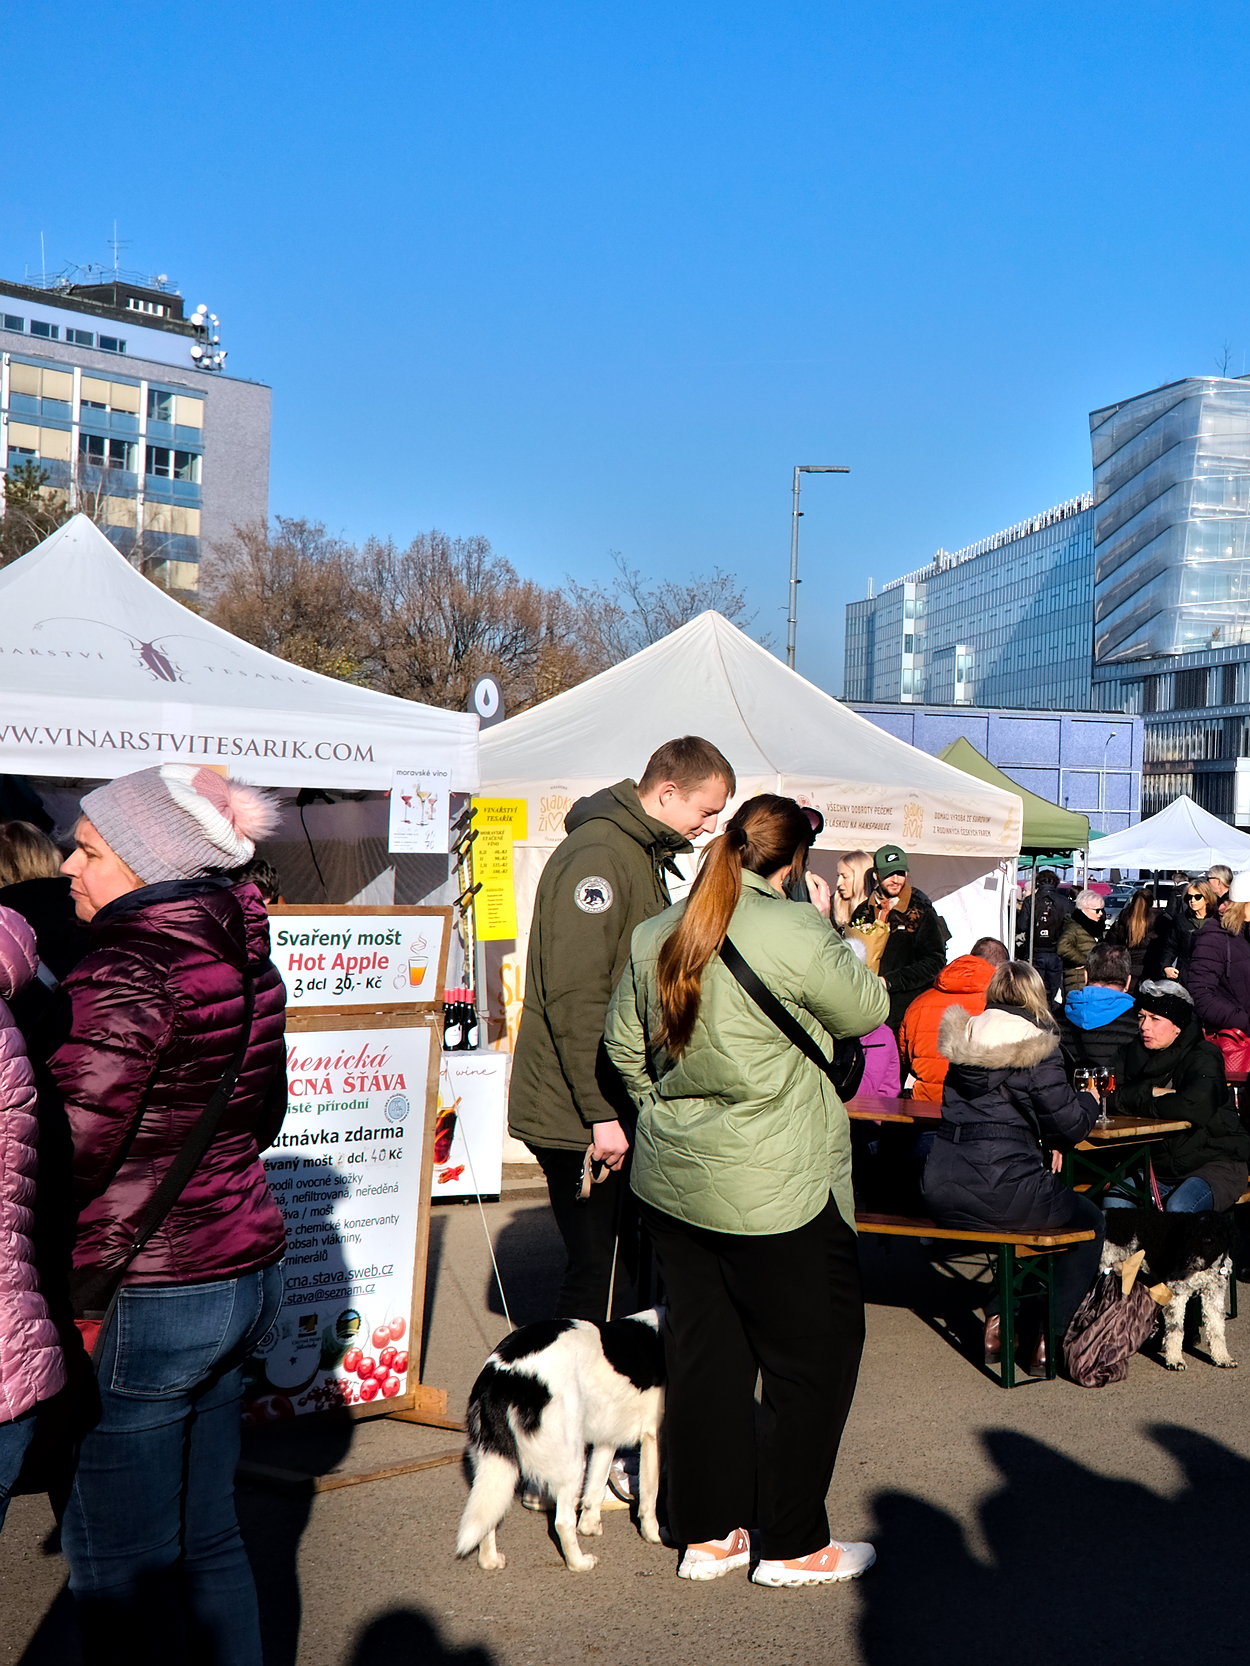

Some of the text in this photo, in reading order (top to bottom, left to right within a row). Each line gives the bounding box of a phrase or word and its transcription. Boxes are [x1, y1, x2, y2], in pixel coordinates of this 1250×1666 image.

[396, 769, 449, 777] moravské víno
[483, 806, 518, 814] VINAŘSTVÍ
[826, 801, 893, 816] VŠECHNY DOBROTY PEČEME
[829, 817, 849, 830] LÁSKOU
[849, 819, 857, 829] NA
[858, 820, 892, 831] HANSPAULCE
[276, 928, 402, 950] Svařený mošt
[288, 951, 389, 974] Hot Apple
[307, 978, 327, 990] dcl
[365, 975, 382, 989] Kč
[455, 1065, 497, 1077] wine
[288, 1070, 407, 1097] CNÁ ŠŤÁVA
[287, 1101, 313, 1114] istě
[317, 1097, 369, 1115] přírodní
[271, 1125, 404, 1148] utnávka zdarma
[263, 1155, 300, 1171] évaný
[302, 1153, 333, 1168] mošt
[347, 1152, 368, 1164] dcl.
[388, 1148, 403, 1160] Kč
[296, 1175, 331, 1189] ovocné
[334, 1173, 363, 1187] složky
[274, 1182, 399, 1206] ná, nefiltrovaná, neředěná
[281, 1209, 299, 1220] áva
[310, 1204, 334, 1217] mošt
[295, 1220, 341, 1235] chemické
[343, 1213, 400, 1230] konzervanty
[288, 1231, 362, 1250] obsah vlákniny,
[285, 1249, 328, 1265] minerálů
[286, 1264, 394, 1289] cna.stava.sweb.cz
[283, 1283, 376, 1305] .stava@seznam.cz
